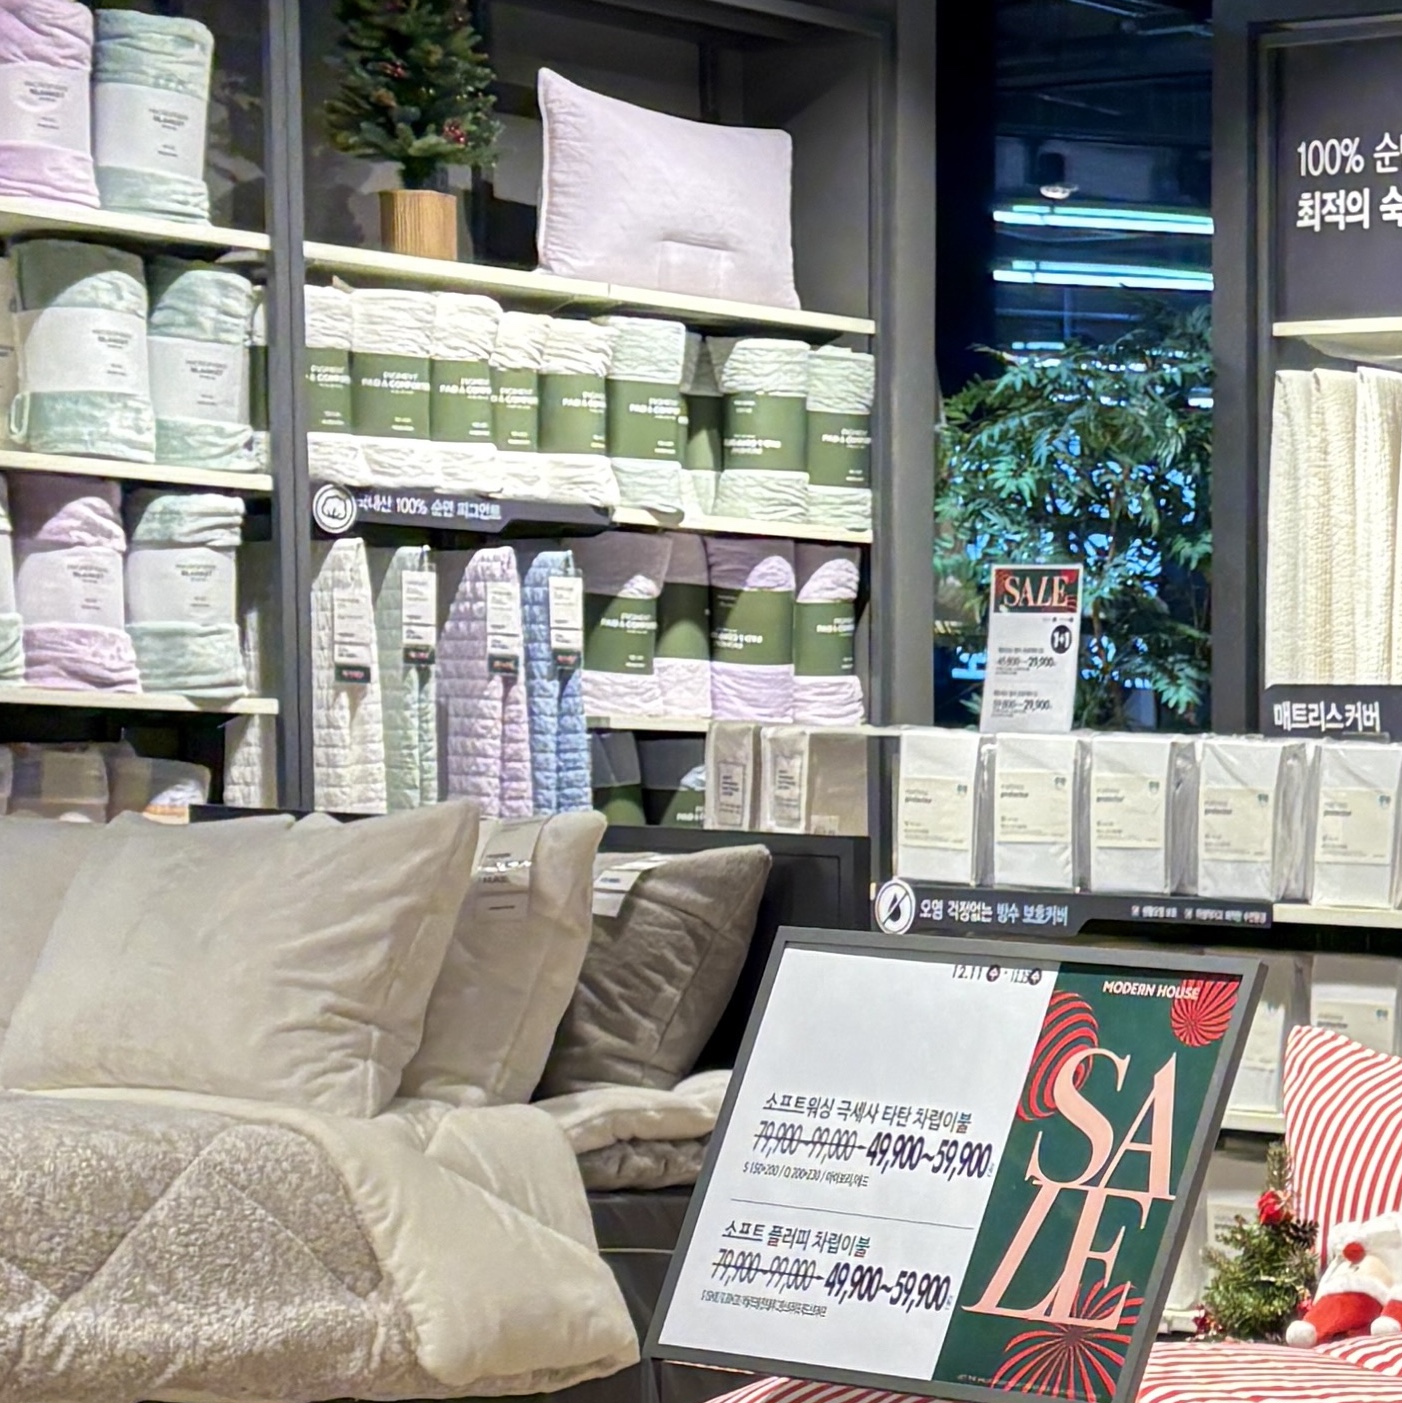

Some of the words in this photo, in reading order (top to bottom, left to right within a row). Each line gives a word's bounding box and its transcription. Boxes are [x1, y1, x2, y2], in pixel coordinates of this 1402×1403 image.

[1297, 137, 1365, 177] 100%
[1296, 187, 1371, 233] 최적의
[395, 496, 428, 515] 100%
[1003, 576, 1069, 607] SALE
[1273, 701, 1381, 733] 매트리스커버
[919, 901, 943, 919] 오염
[946, 900, 993, 924] 걱정없는
[996, 904, 1019, 925] 방수
[1022, 904, 1069, 927] 보호커버
[1102, 979, 1155, 998] MODERN
[1156, 982, 1201, 1000] HOUSE
[762, 1092, 836, 1120] 소프트워싱
[836, 1099, 880, 1123] 극세사
[881, 1104, 912, 1128] 타탄
[912, 1107, 972, 1135] 차렵이불
[866, 1131, 993, 1182] 49,900~59,900
[721, 1219, 766, 1243] 소프트
[766, 1224, 812, 1250] 플러피
[812, 1230, 871, 1259] 차렵이불
[824, 1261, 952, 1314] 49,900~59,900
